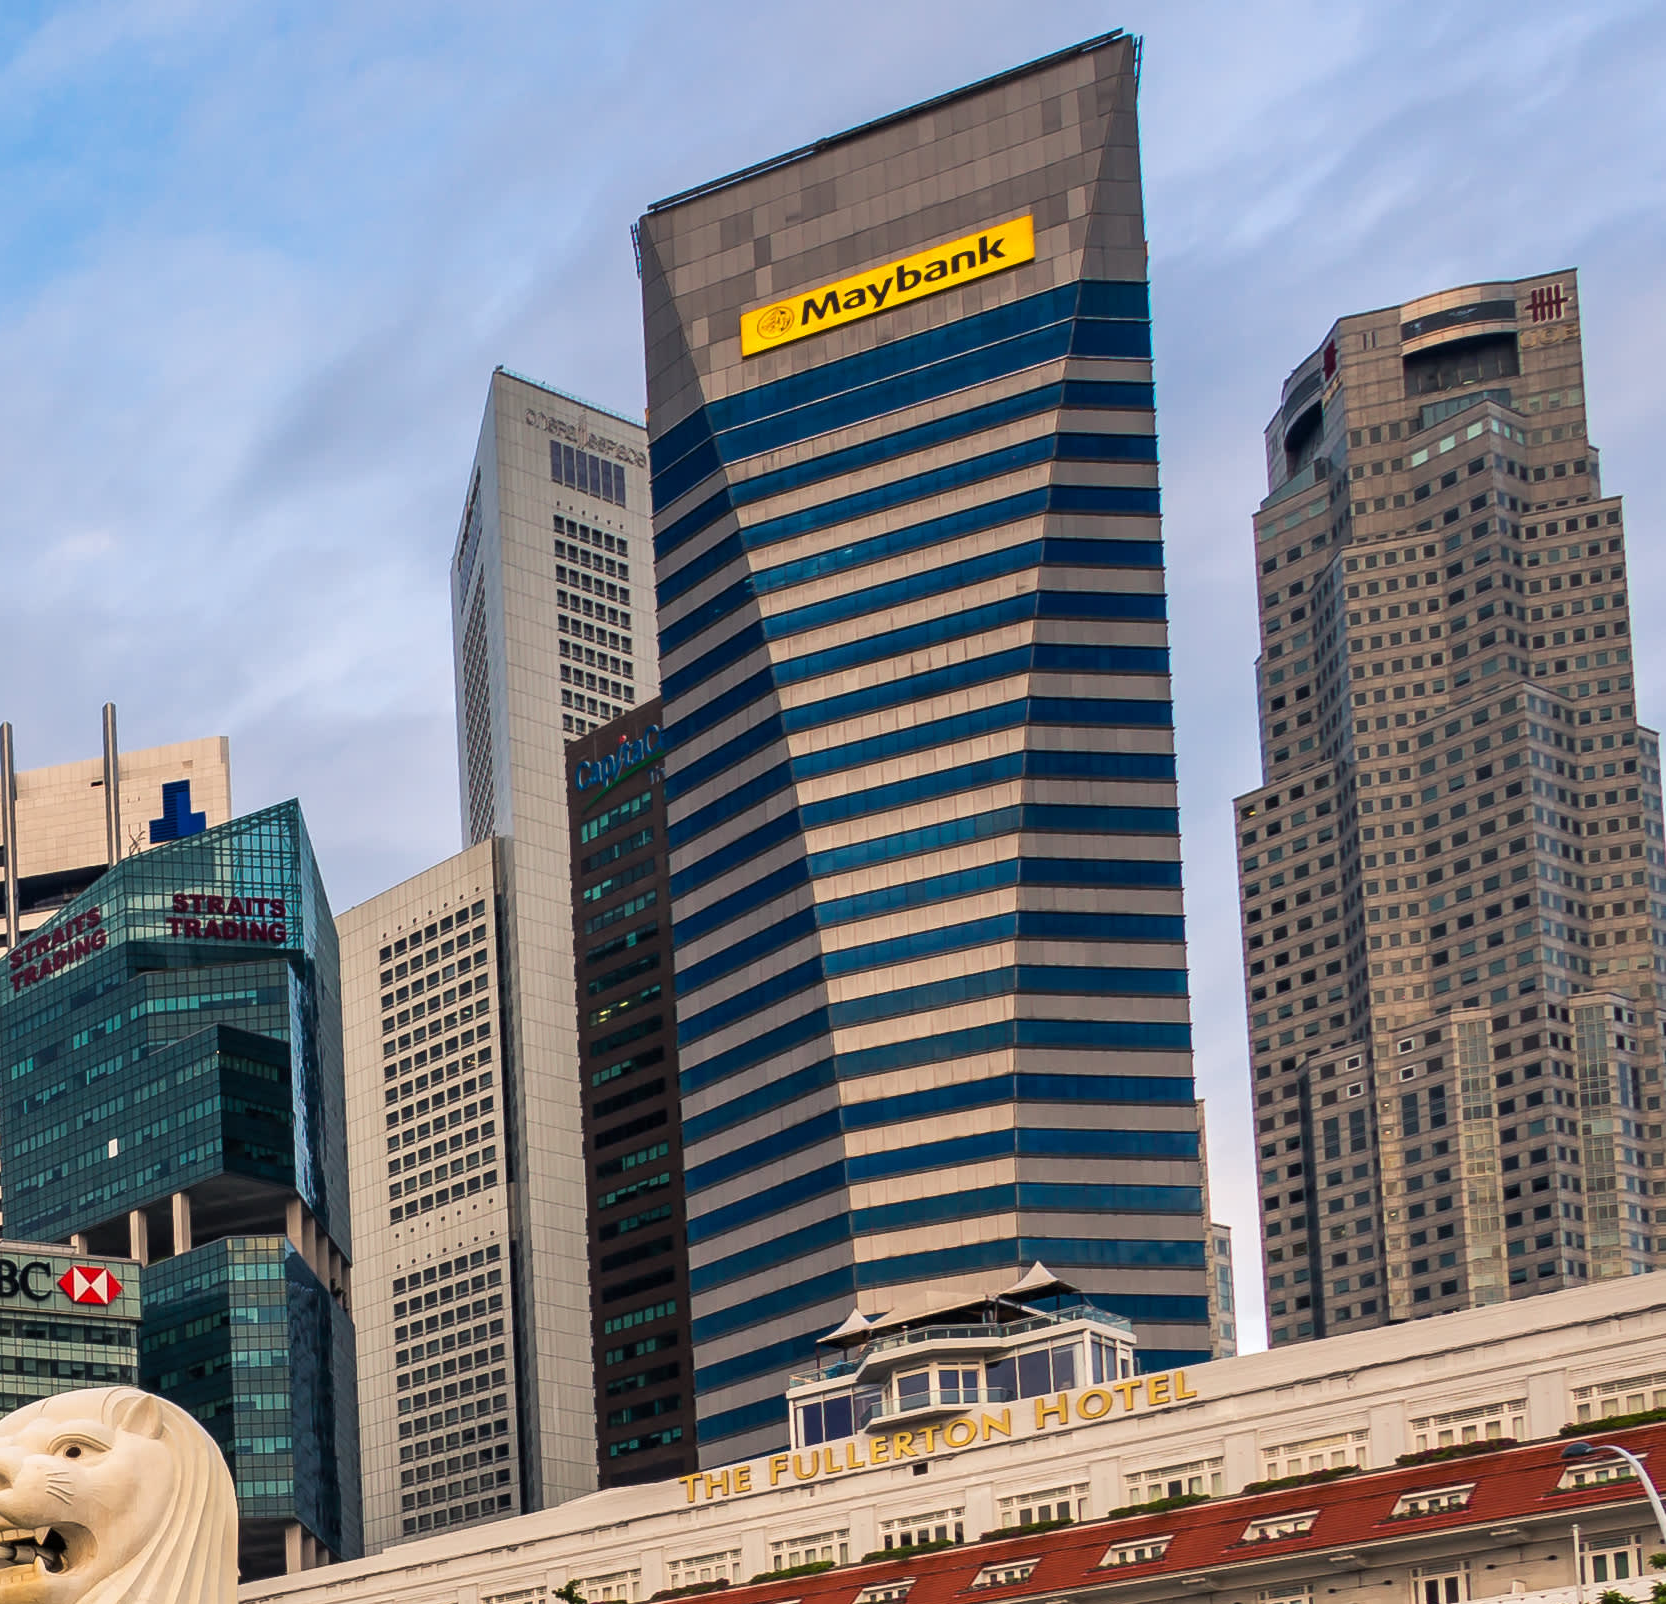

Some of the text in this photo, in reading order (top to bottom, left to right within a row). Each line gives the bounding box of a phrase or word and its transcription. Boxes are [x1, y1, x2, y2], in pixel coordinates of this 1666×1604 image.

[801, 236, 1006, 326] Maybank
[165, 916, 287, 943] TRADING
[172, 893, 287, 918] STRAITS
[10, 906, 102, 970] STRAITS
[10, 928, 107, 992] TRADING
[679, 1370, 1198, 1503] THE FULLERTON HOTEL
